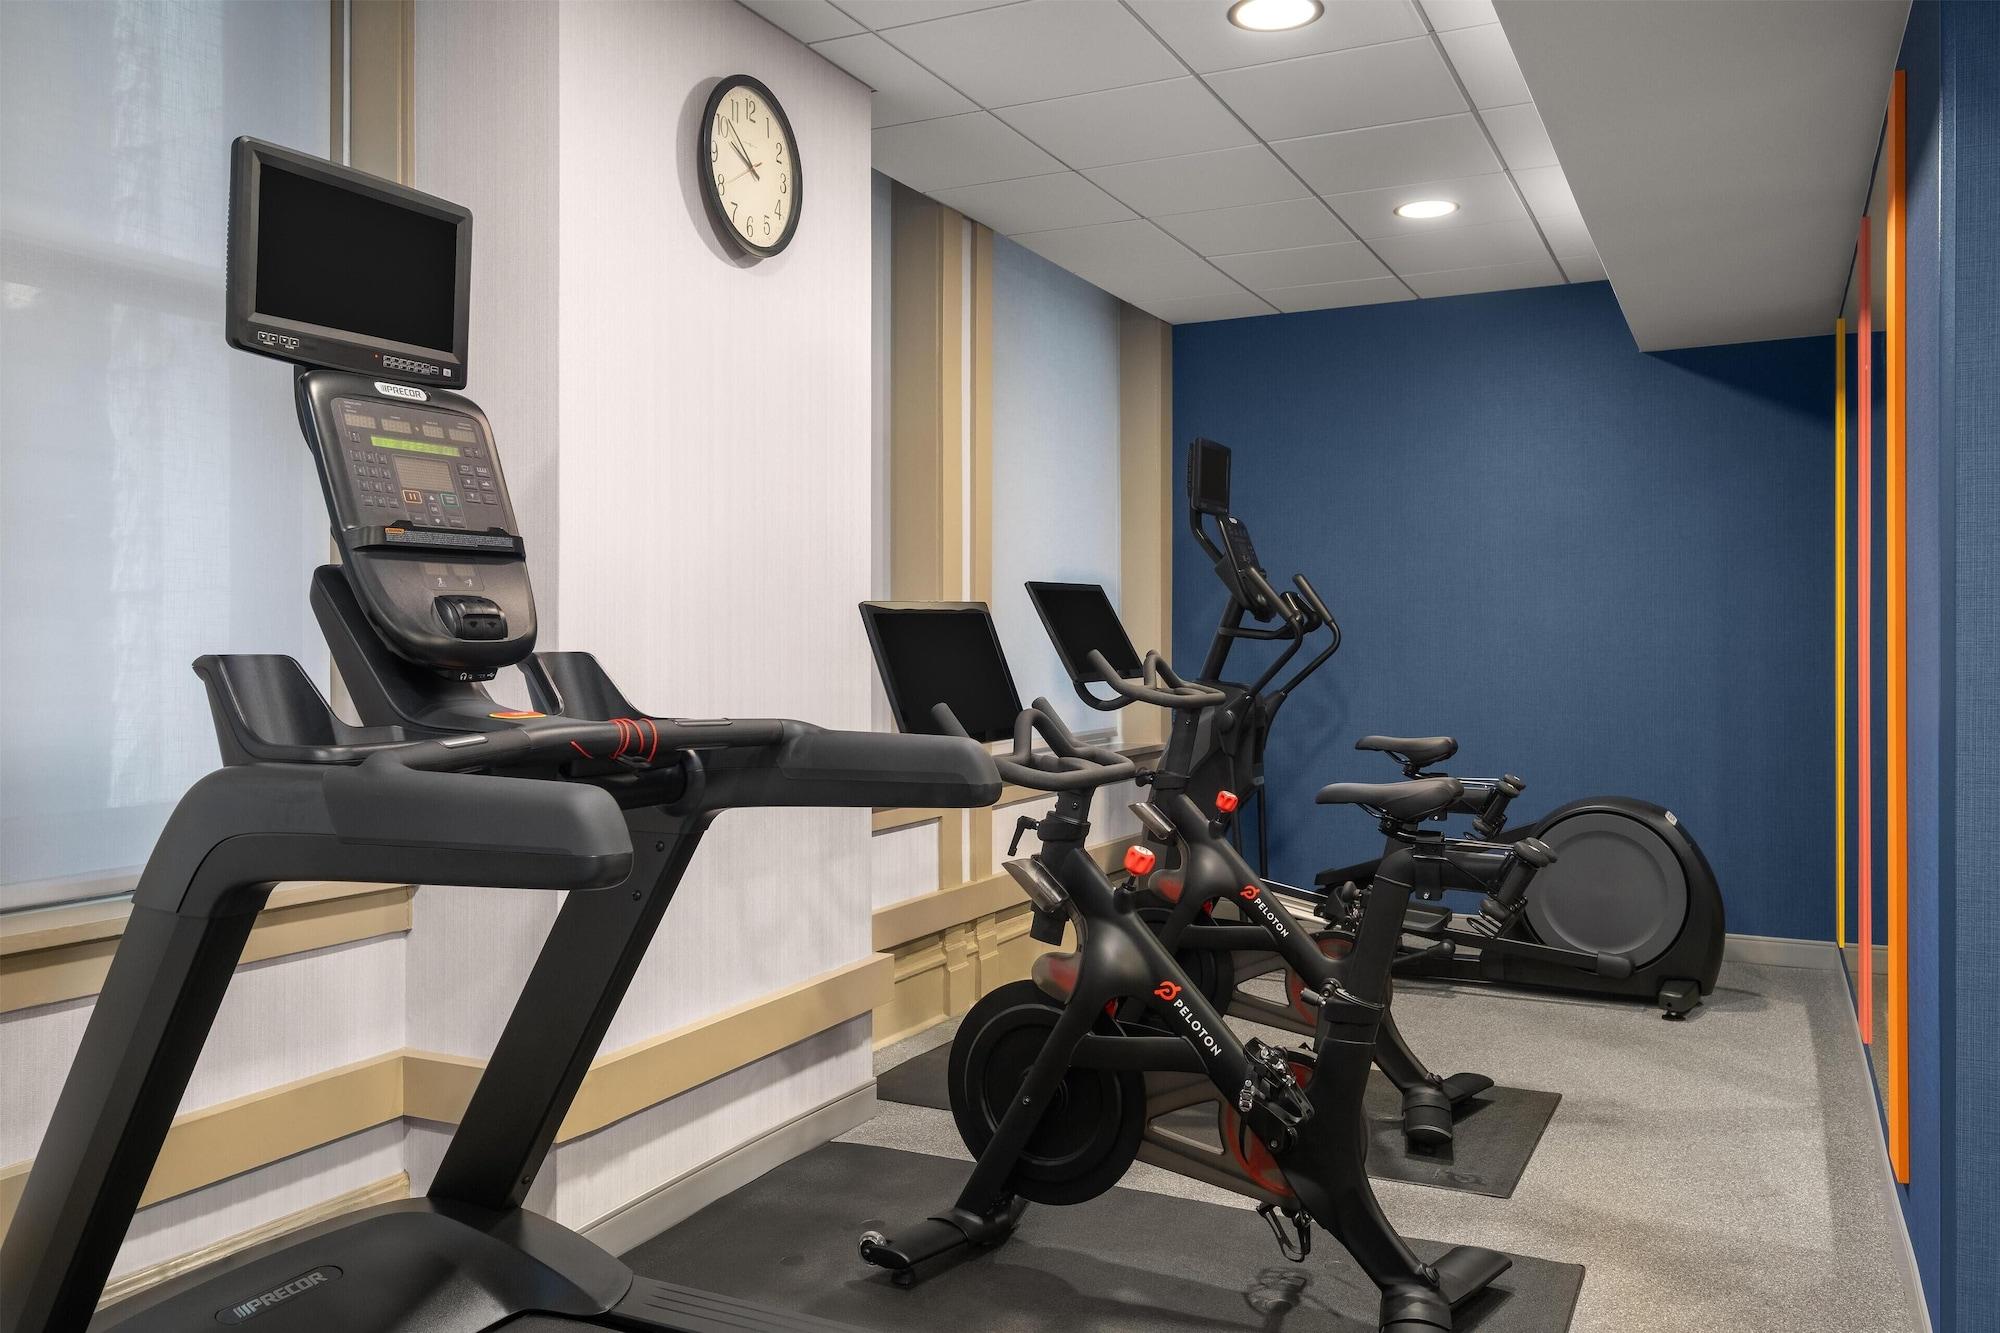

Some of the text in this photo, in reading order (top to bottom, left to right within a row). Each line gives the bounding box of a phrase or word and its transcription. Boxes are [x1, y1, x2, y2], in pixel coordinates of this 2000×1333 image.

[730, 98, 739, 124] 11
[745, 97, 756, 124] 12
[716, 113, 729, 139] 10
[766, 117, 770, 139] 1
[711, 140, 719, 163] 9
[775, 142, 783, 165] 2
[717, 173, 725, 197] 8
[779, 172, 787, 195] 3
[731, 201, 738, 223] 7
[774, 199, 782, 221] 4
[746, 215, 754, 238] 6
[763, 214, 771, 236] 5
[386, 385, 422, 398] PRECOR
[1253, 897, 1289, 937] PELOTON
[1173, 998, 1222, 1056] PELOTON
[246, 1271, 329, 1313] PRECOR
